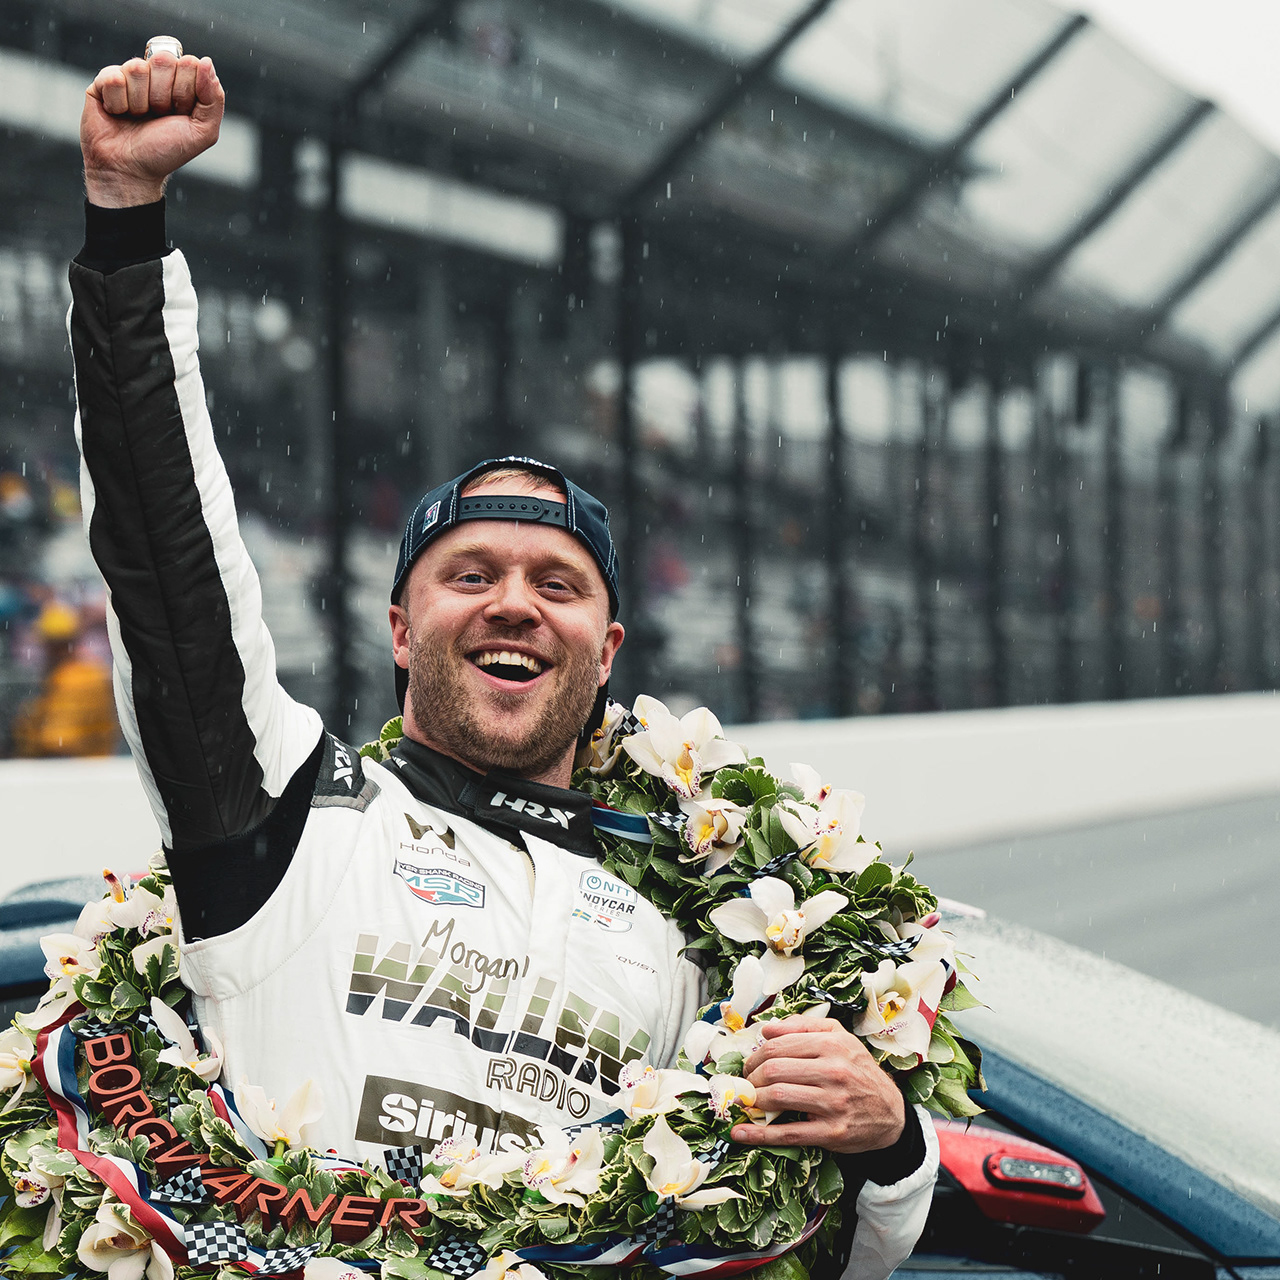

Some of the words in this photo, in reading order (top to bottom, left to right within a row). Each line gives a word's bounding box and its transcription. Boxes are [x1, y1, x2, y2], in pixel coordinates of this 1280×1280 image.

[603, 881, 632, 897] NTT
[580, 891, 636, 915] NDYCAR
[615, 954, 659, 974] QVIST
[486, 1056, 591, 1120] RADIO
